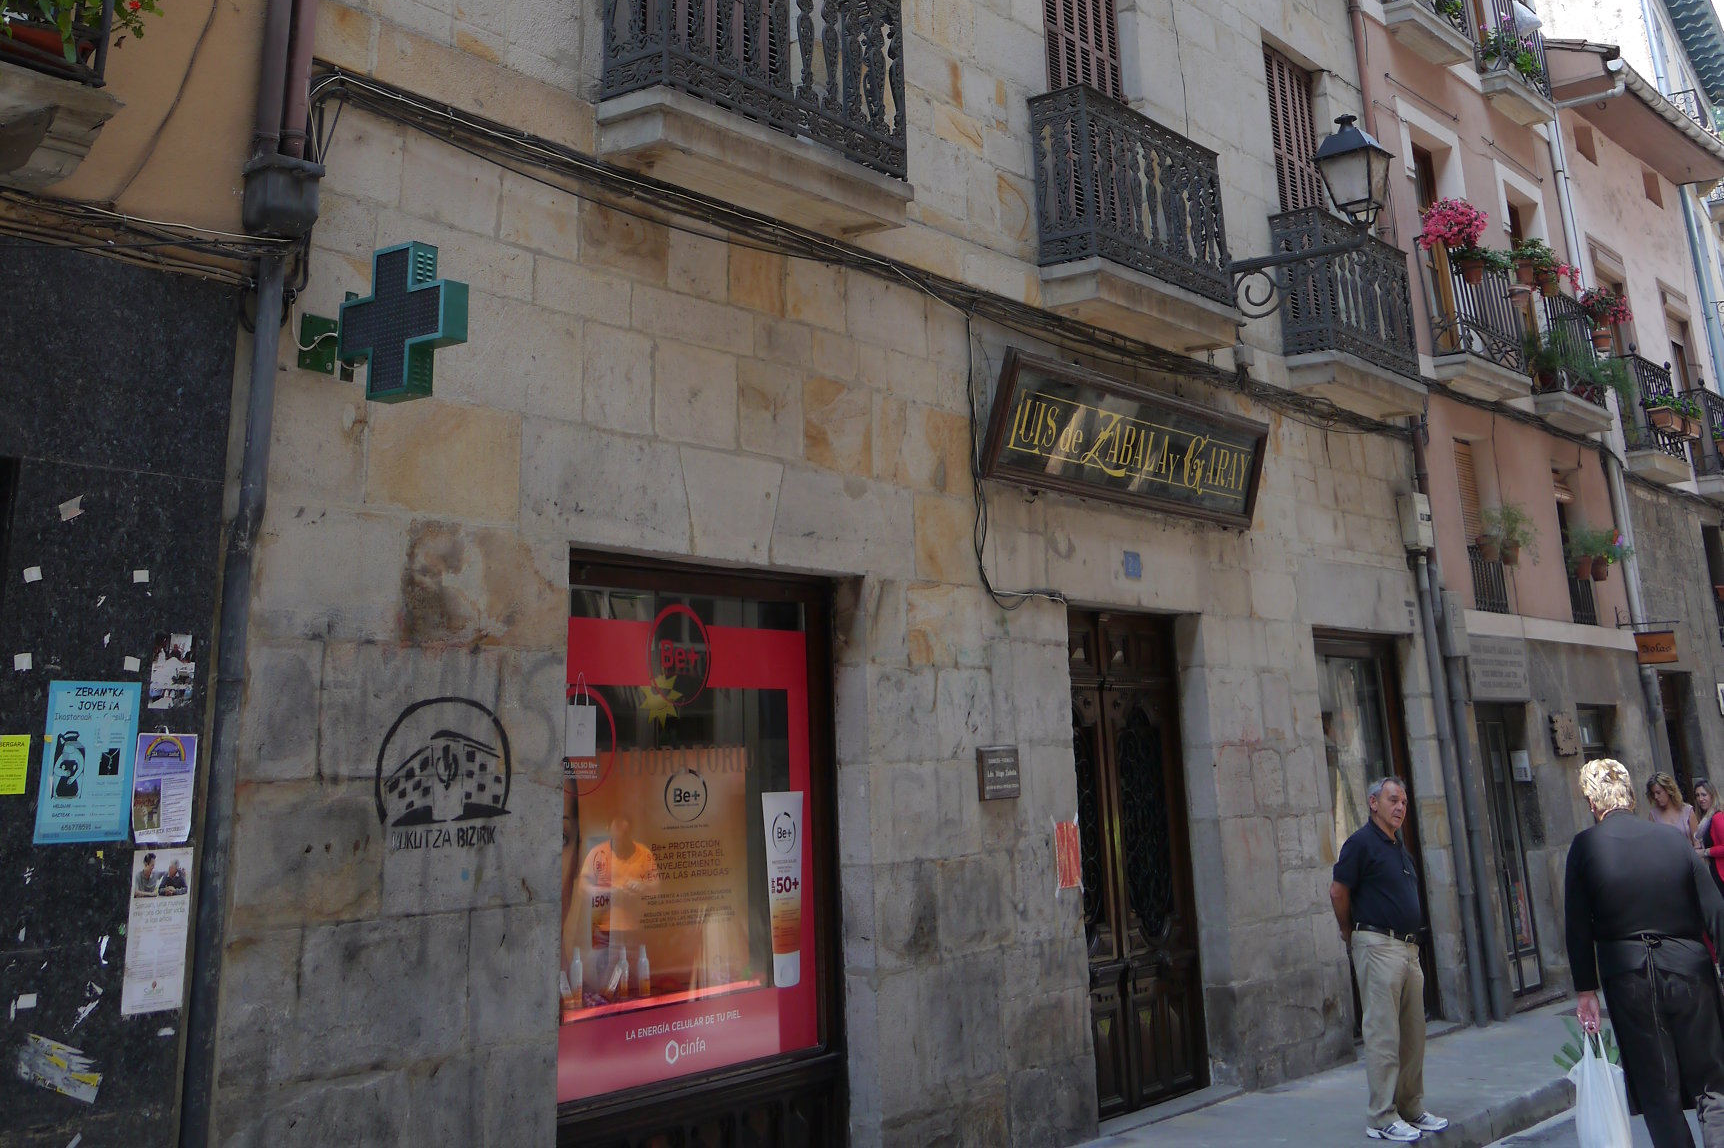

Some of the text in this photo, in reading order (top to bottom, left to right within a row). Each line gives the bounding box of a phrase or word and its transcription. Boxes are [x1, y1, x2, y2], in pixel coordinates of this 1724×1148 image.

[1060, 413, 1083, 453] de
[661, 639, 699, 669] Be+
[673, 788, 700, 803] Be+
[777, 827, 792, 839] Be+
[676, 851, 713, 859] RETRASA
[673, 871, 688, 879] LAS
[776, 876, 799, 893] 50+
[626, 1010, 741, 1040] LA ENERGÍA CELULAR DE TU PIEL
